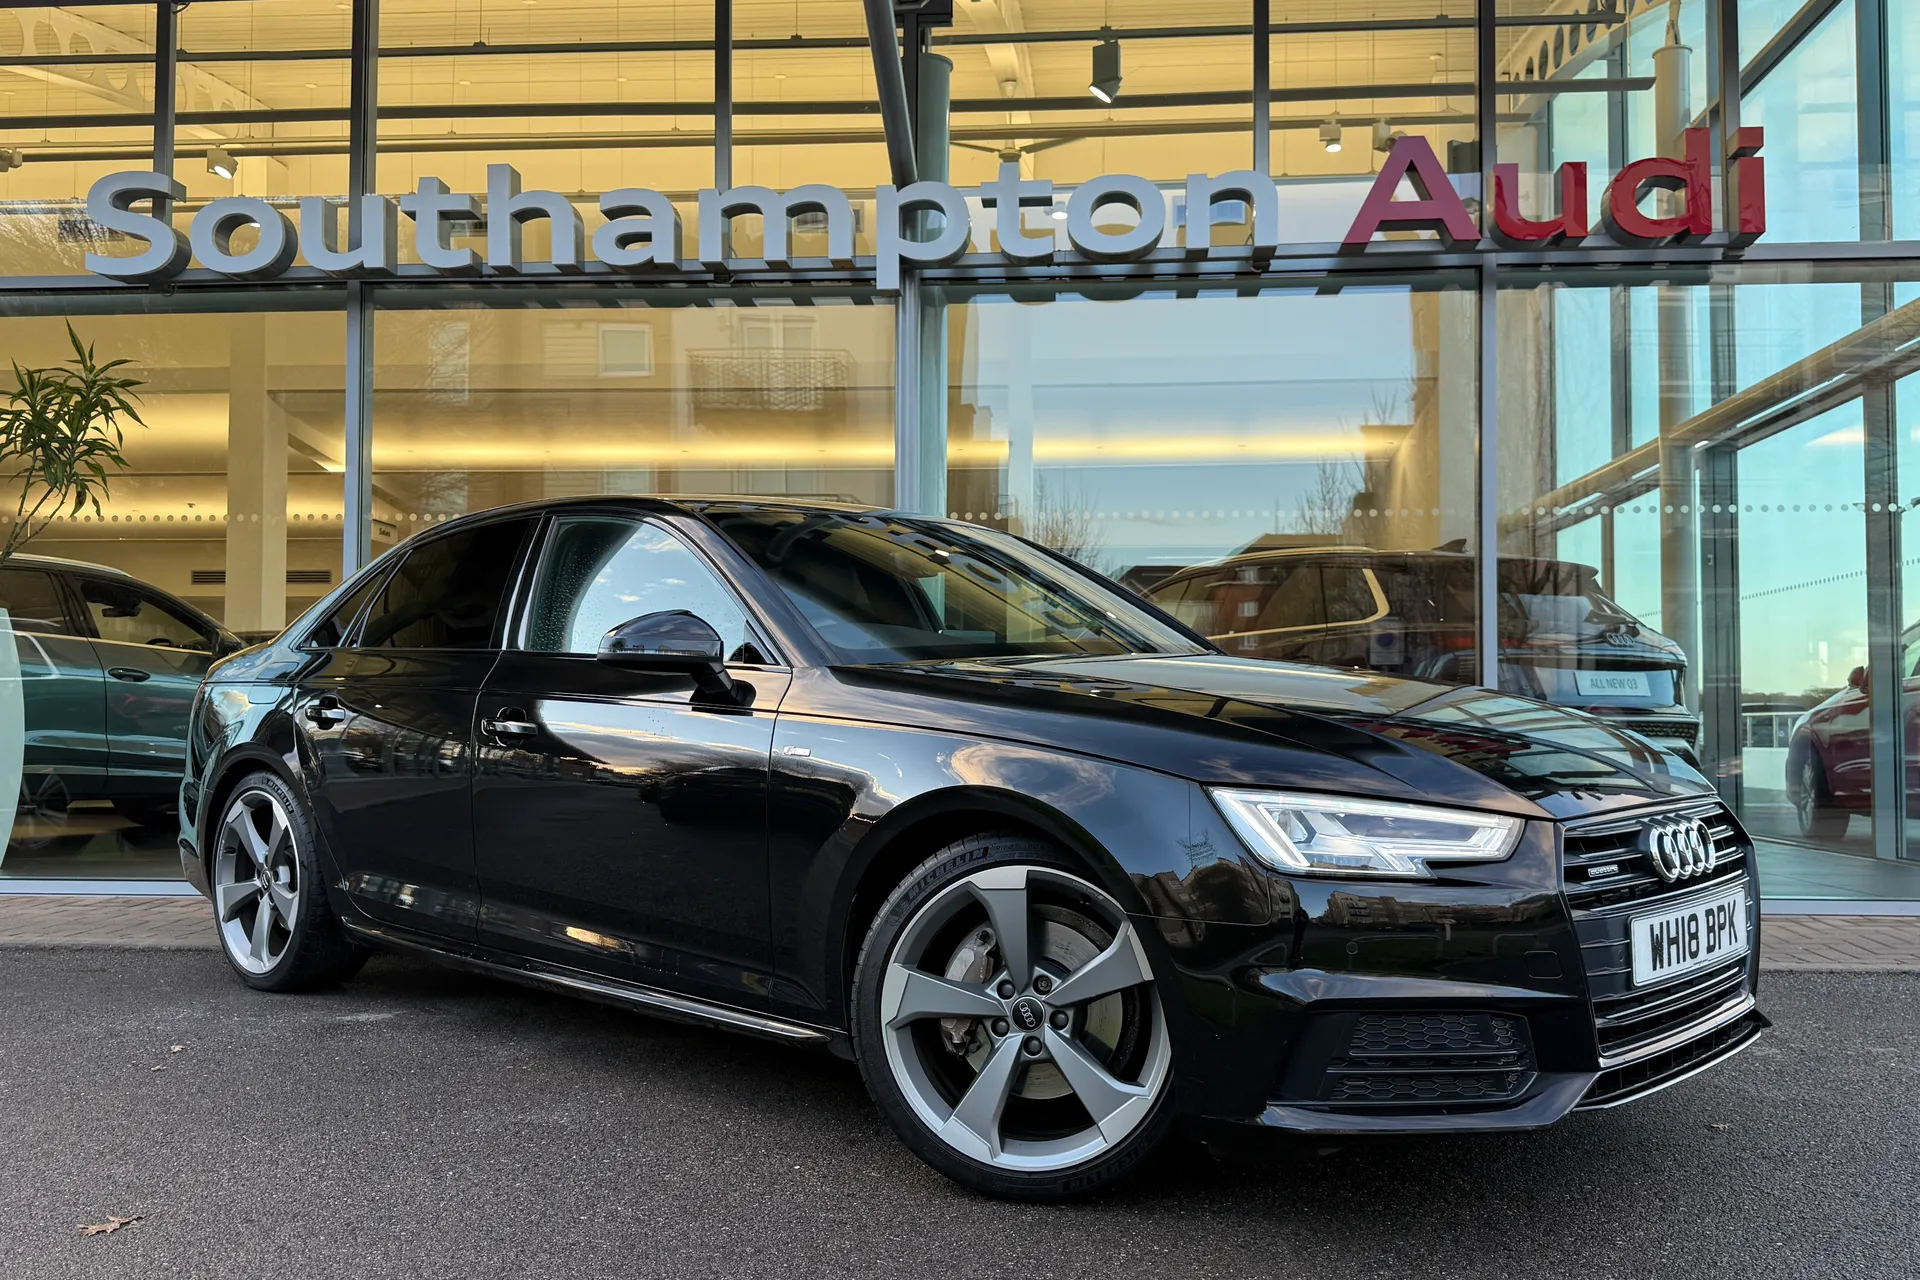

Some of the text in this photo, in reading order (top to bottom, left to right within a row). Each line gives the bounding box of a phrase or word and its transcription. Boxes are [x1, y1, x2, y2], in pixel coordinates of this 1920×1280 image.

[85, 126, 1766, 291] Southampton Audi
[379, 527, 391, 538] Sales
[1590, 678, 1638, 690] ALL NEW Q3
[908, 848, 986, 900] MICHELIN
[1590, 865, 1618, 876] quattro
[1649, 900, 1738, 971] WH18 BPK
